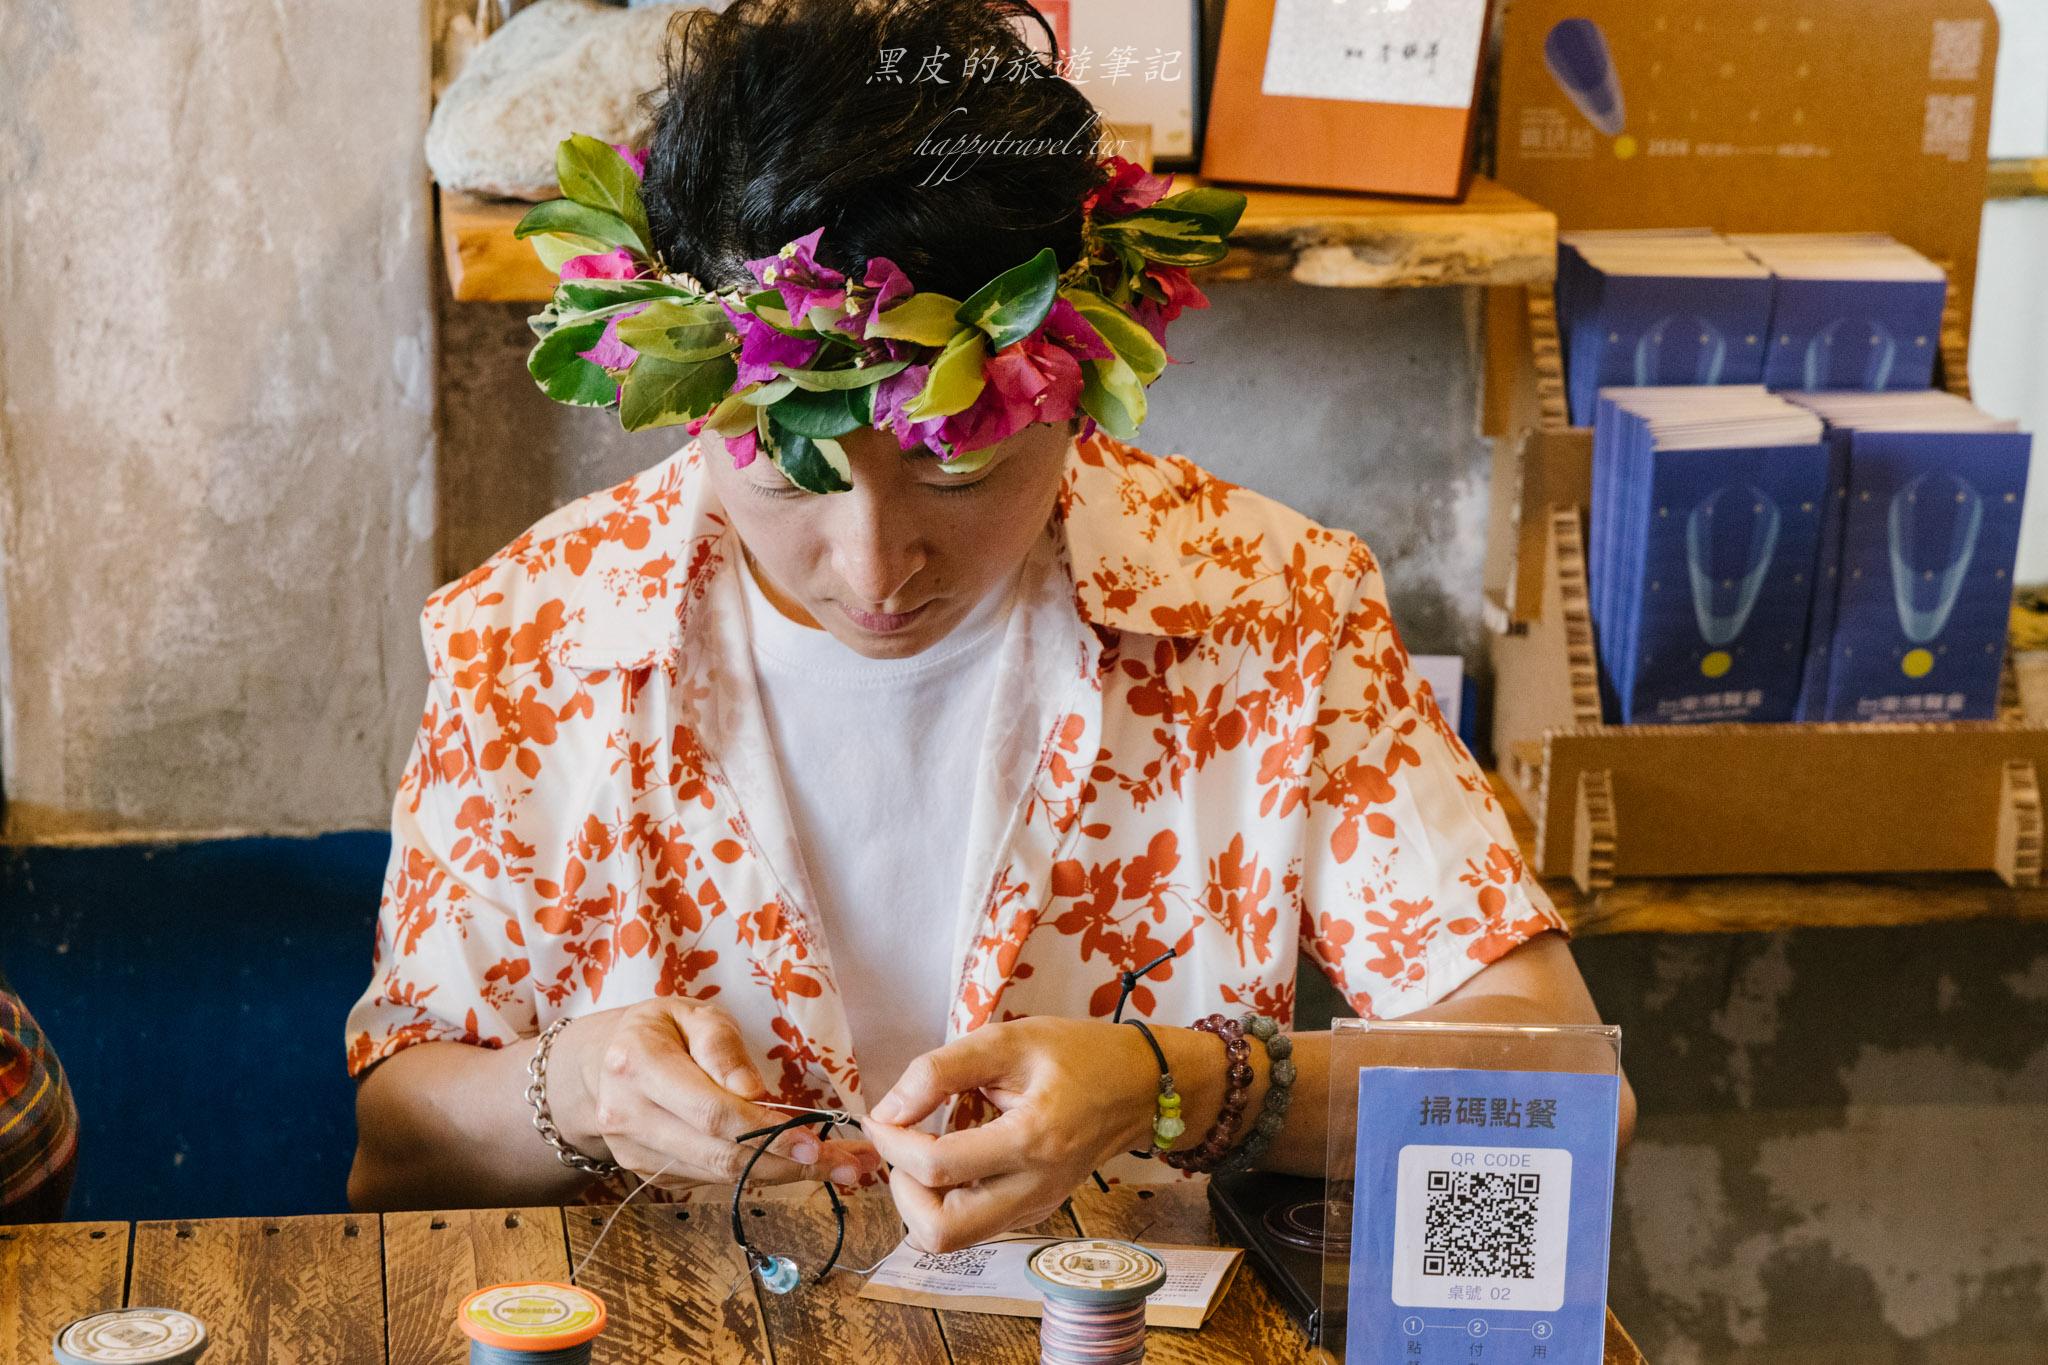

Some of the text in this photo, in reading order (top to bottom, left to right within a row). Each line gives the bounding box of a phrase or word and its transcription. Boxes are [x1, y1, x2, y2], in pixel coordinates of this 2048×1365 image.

[1419, 1095, 1558, 1130] 掃碼點餐
[1451, 1151, 1531, 1168] QR CODE
[1448, 1285, 1512, 1301] 桌號 02
